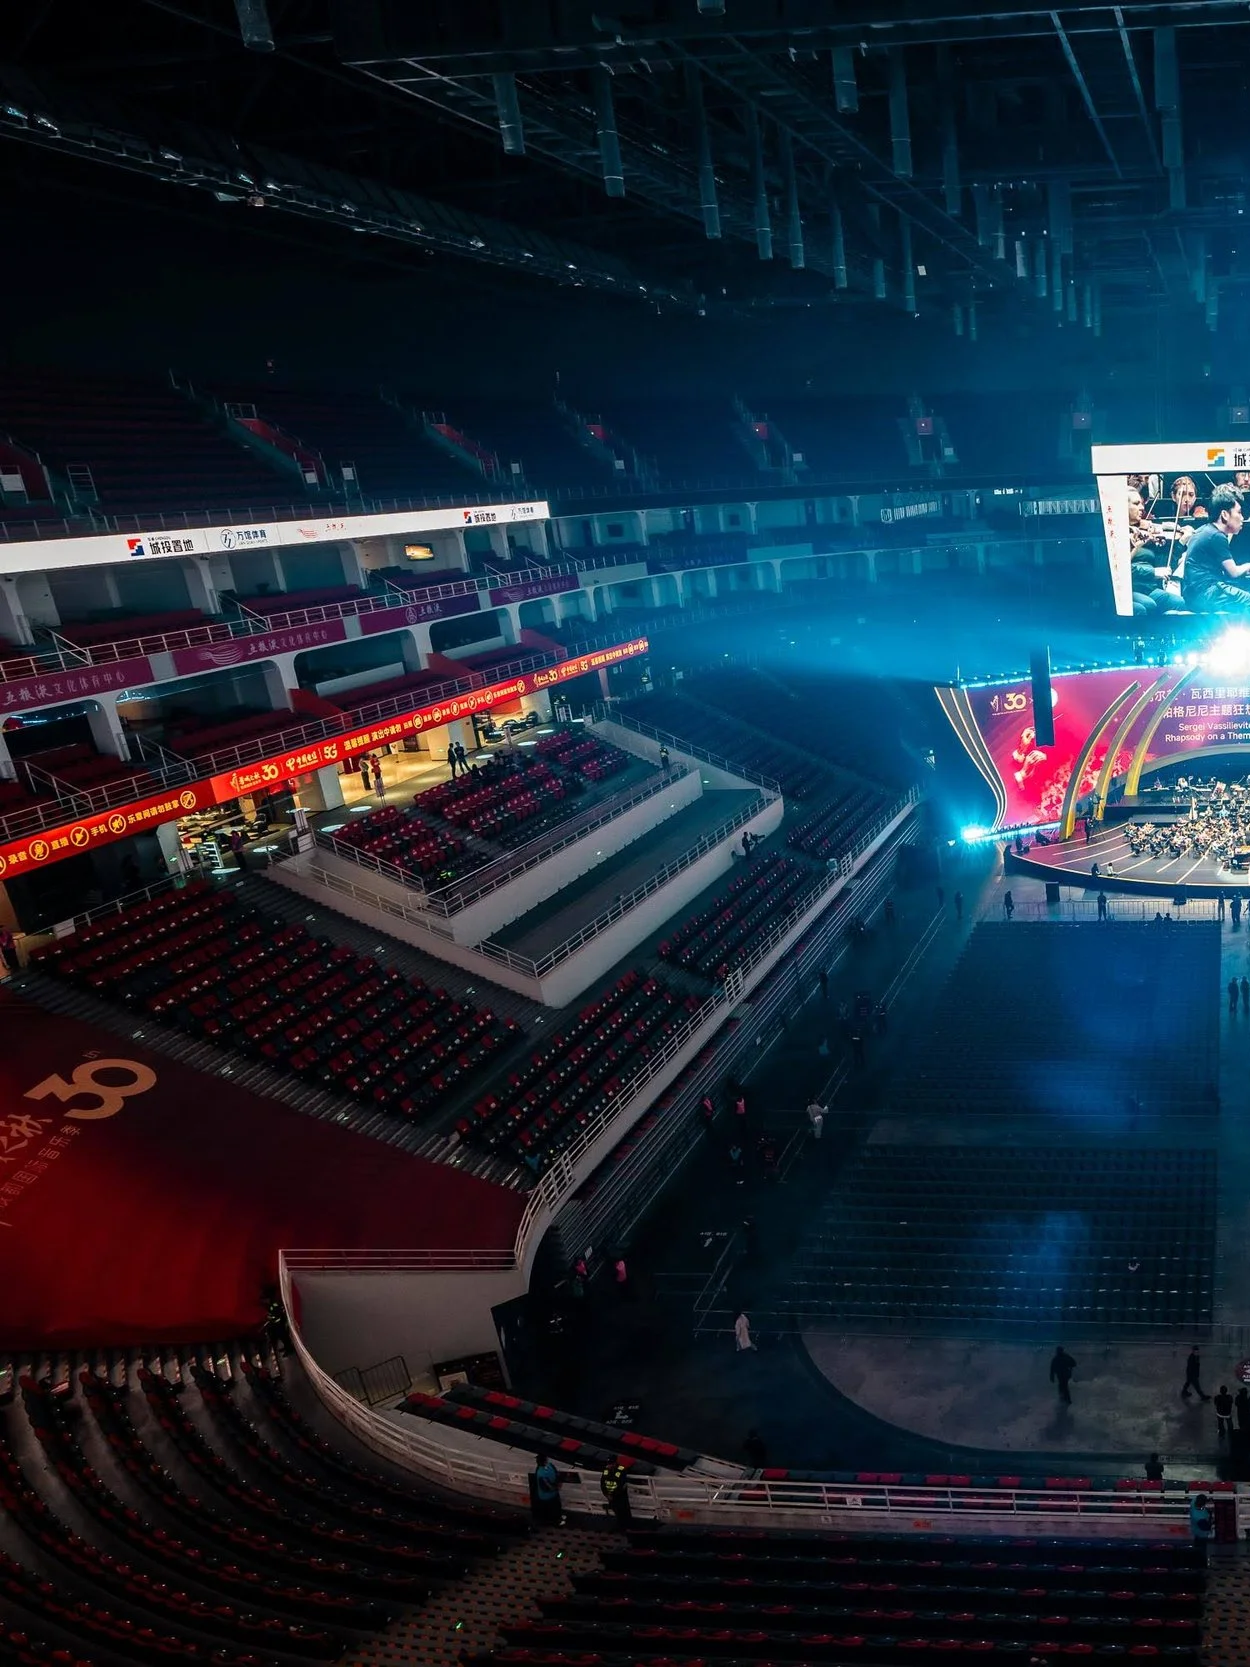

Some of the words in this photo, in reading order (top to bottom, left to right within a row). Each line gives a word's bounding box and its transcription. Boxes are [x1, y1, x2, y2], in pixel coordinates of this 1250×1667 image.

[149, 538, 194, 555] 城投置地
[247, 629, 328, 656] 五粮液文化体育中心
[4, 670, 125, 705] 五粮液文化体育中心
[1004, 692, 1027, 711] 30
[1178, 722, 1206, 733] Sergei
[1165, 733, 1206, 743] Rhapsody
[323, 743, 338, 759] 5G
[261, 764, 279, 781] 30
[127, 799, 180, 825] 乐章间请勿鼓掌
[90, 824, 108, 837] 手机
[51, 836, 69, 851] 直播
[8, 849, 28, 865] 录音
[24, 1058, 157, 1120] 30
